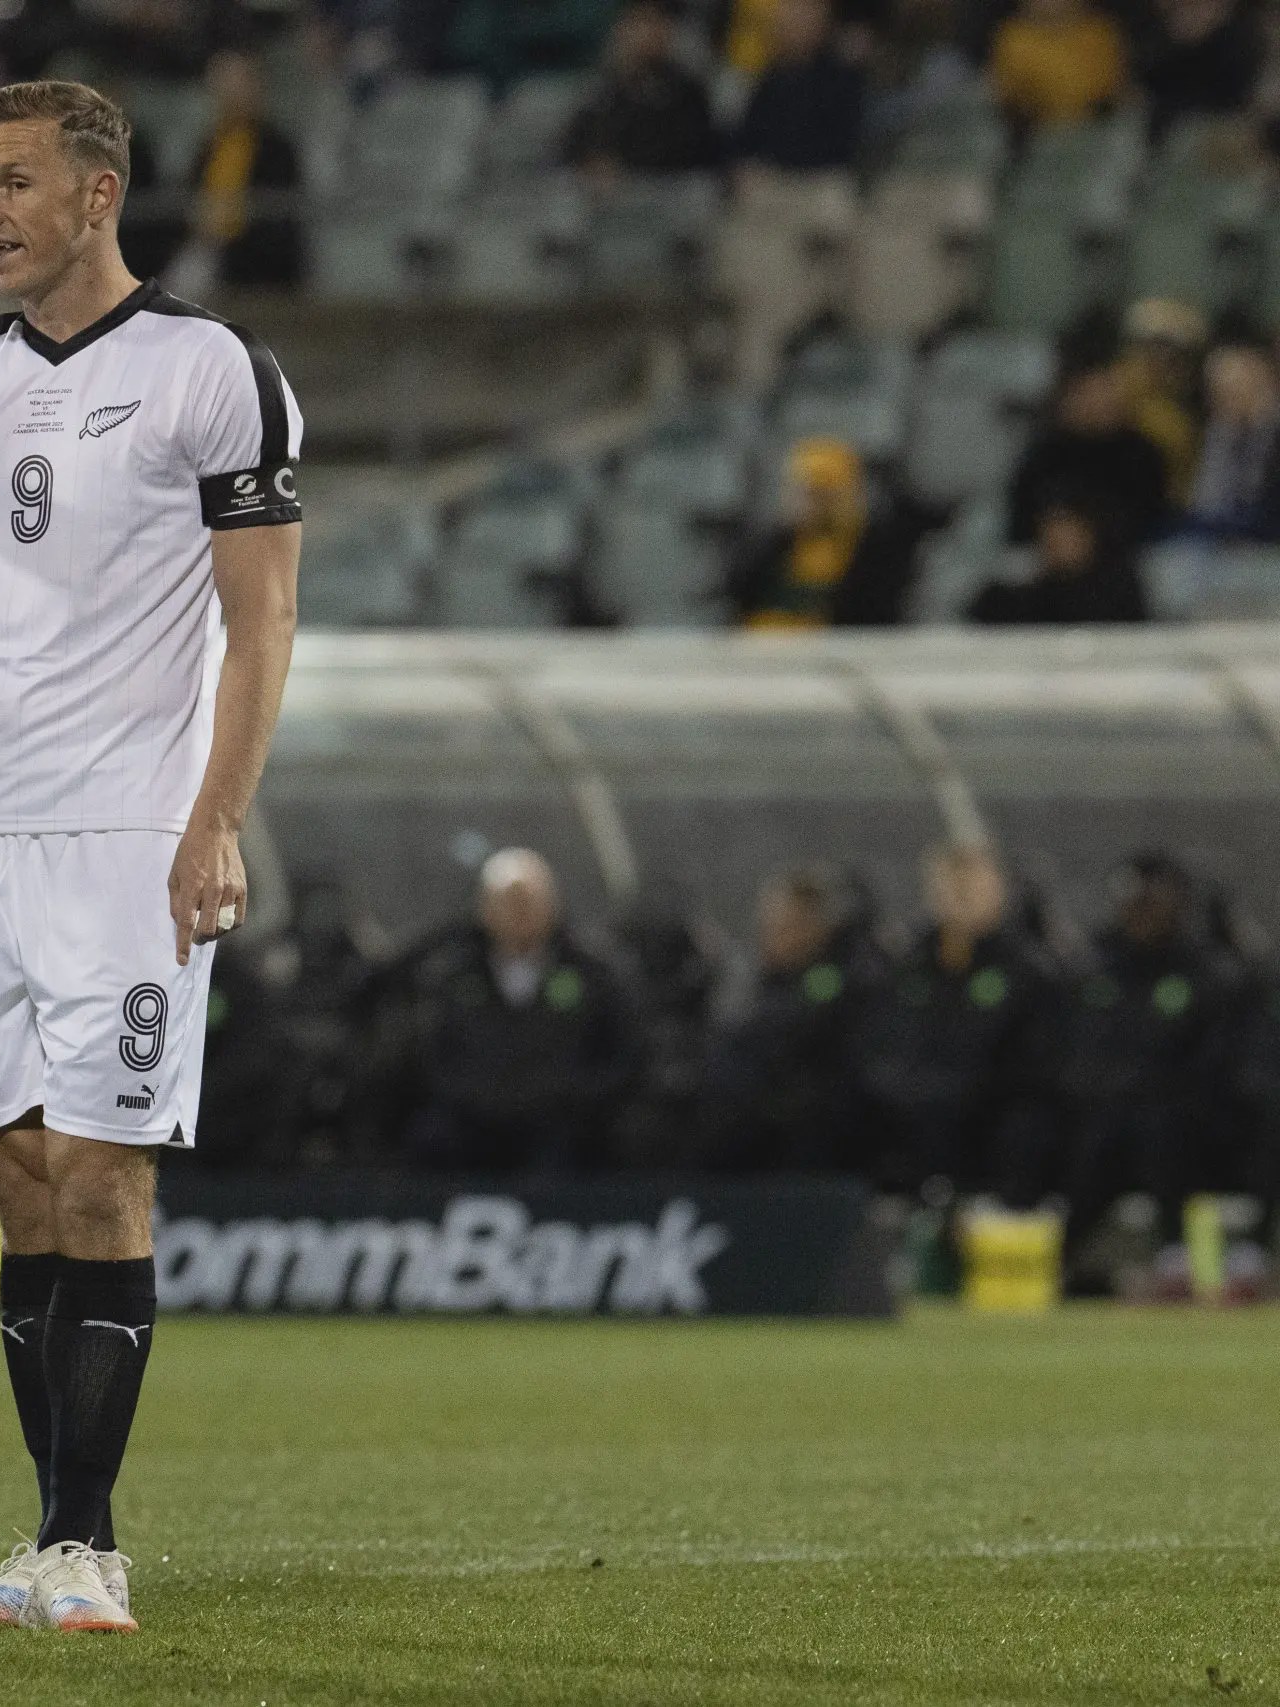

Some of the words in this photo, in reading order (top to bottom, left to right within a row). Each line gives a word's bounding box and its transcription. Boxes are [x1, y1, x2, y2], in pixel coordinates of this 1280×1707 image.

[11, 454, 53, 544] 9
[245, 493, 266, 501] Zealand
[274, 467, 297, 499] C
[238, 499, 260, 507] Football
[118, 982, 169, 1072] 9
[116, 1094, 152, 1110] PUMA
[154, 1196, 728, 1312] ommBank
